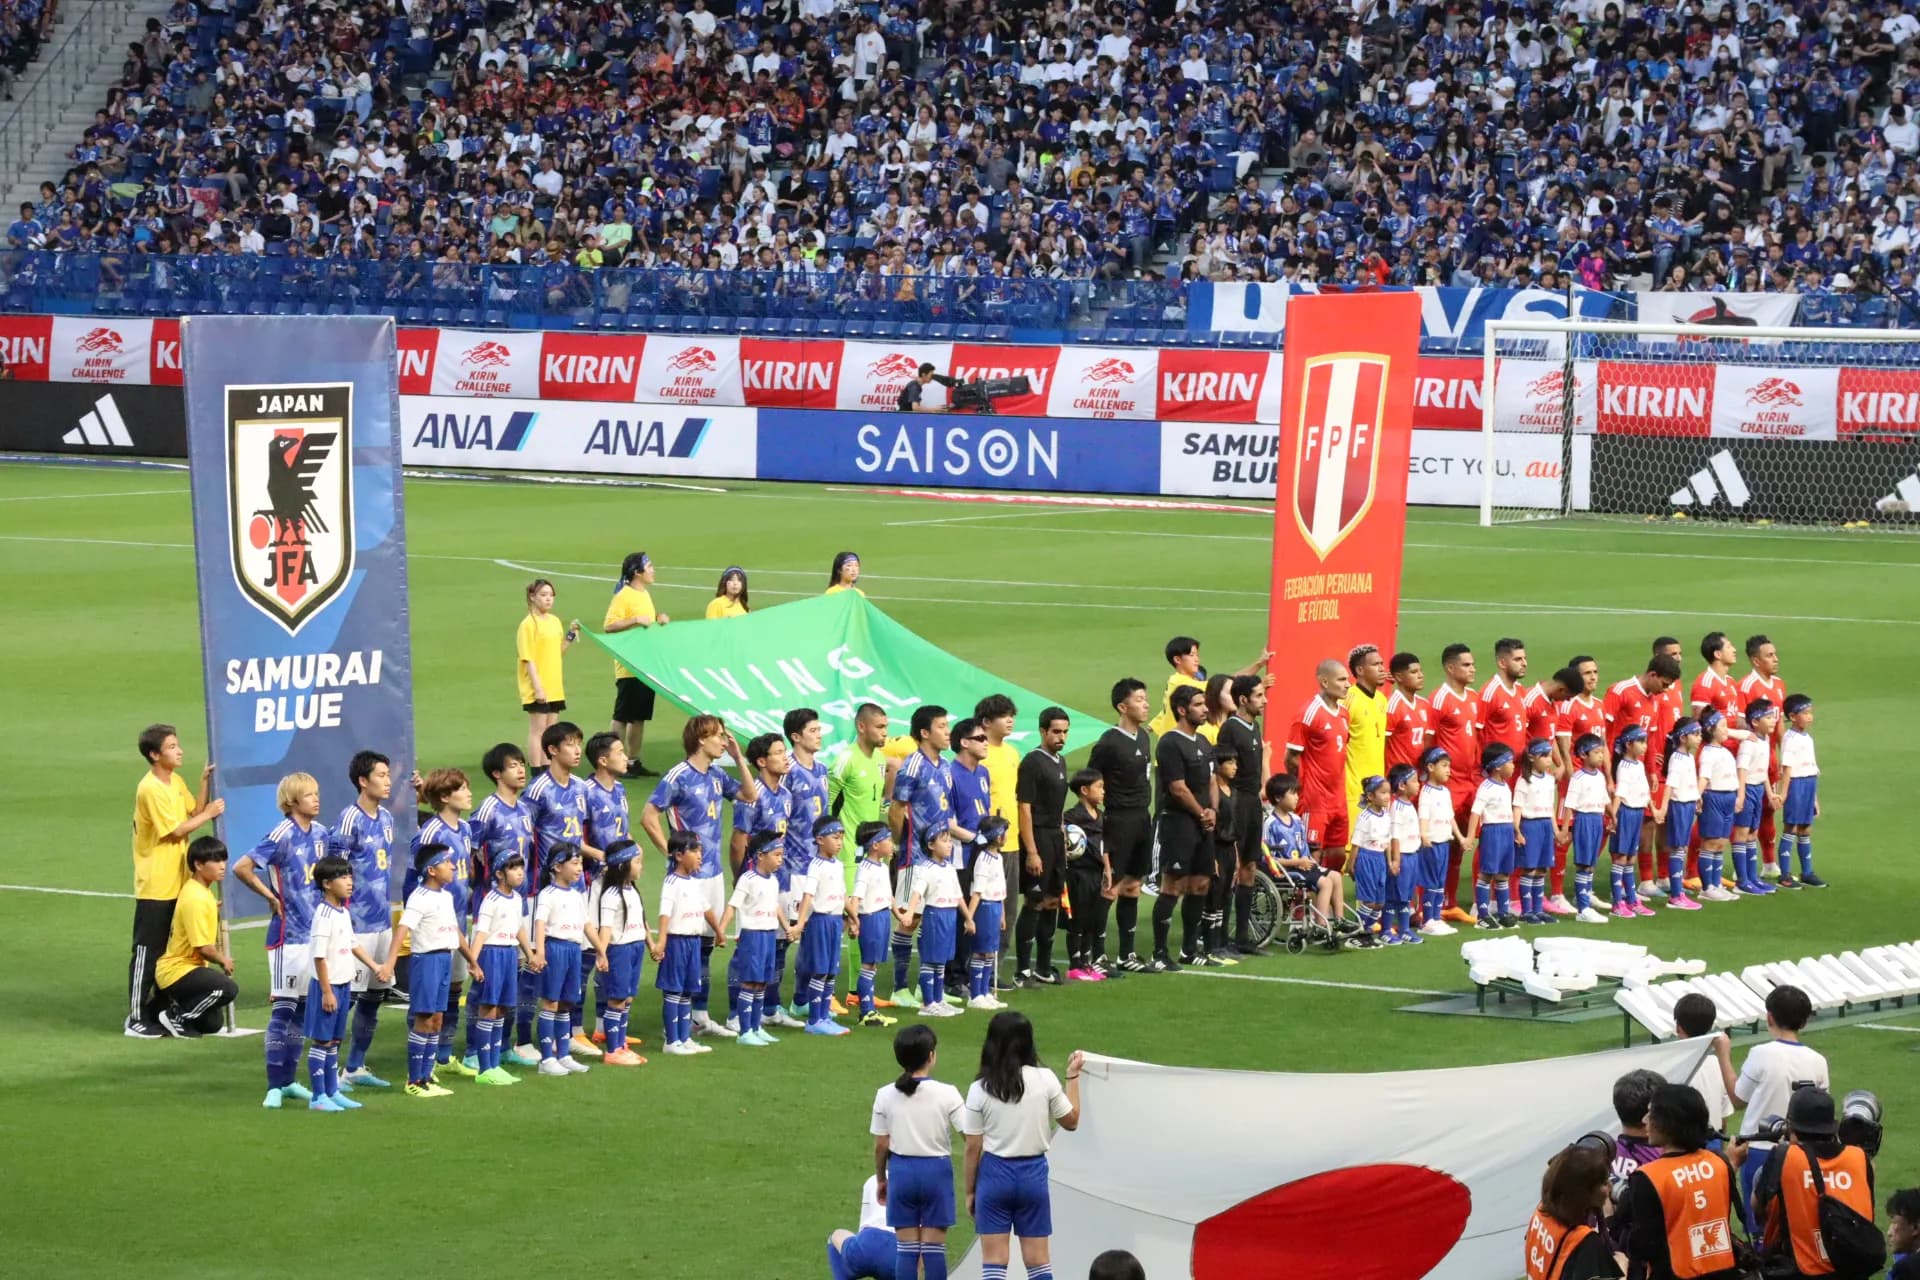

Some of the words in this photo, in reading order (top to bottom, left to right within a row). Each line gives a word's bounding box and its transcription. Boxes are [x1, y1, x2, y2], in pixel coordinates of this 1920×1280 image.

[72, 368, 126, 380] CHALLENGE
[85, 358, 113, 369] KIRIN
[544, 353, 635, 384] KIRIN
[469, 371, 498, 382] KIRIN
[674, 376, 703, 387] KIRIN
[743, 359, 834, 391] KIRIN
[455, 380, 512, 393] CHALLENGE
[660, 387, 717, 399] CHALLENGE
[1089, 388, 1121, 399] KIRIN
[1162, 372, 1258, 402] KIRIN
[257, 394, 324, 414] JAPAN
[1073, 399, 1136, 411] CHALLENGE
[1603, 383, 1706, 418] KIRIN
[1843, 391, 1920, 424] KIRI
[1756, 411, 1791, 423] KIRIN
[412, 413, 494, 451] ANA
[583, 419, 666, 458] ANA
[1740, 422, 1807, 435] CHALLENGE
[855, 424, 1059, 480] SAISON
[1305, 424, 1369, 462] FPF
[263, 551, 319, 588] JFA
[1326, 572, 1373, 595] PERUANA
[1297, 602, 1308, 624] DE
[225, 649, 383, 695] SAMURAI
[679, 644, 875, 702] IVING
[254, 692, 344, 733] BLUE
[1514, 713, 1523, 732] 5
[1465, 719, 1473, 737] 4
[706, 799, 718, 820] 4
[939, 791, 949, 812] 6
[562, 816, 582, 838] 21
[614, 816, 624, 837] 2
[376, 848, 388, 871] 8
[456, 858, 469, 881] 11
[1671, 1160, 1715, 1189] PHO
[1693, 1189, 1707, 1210] 5
[1530, 1214, 1555, 1255] PHO
